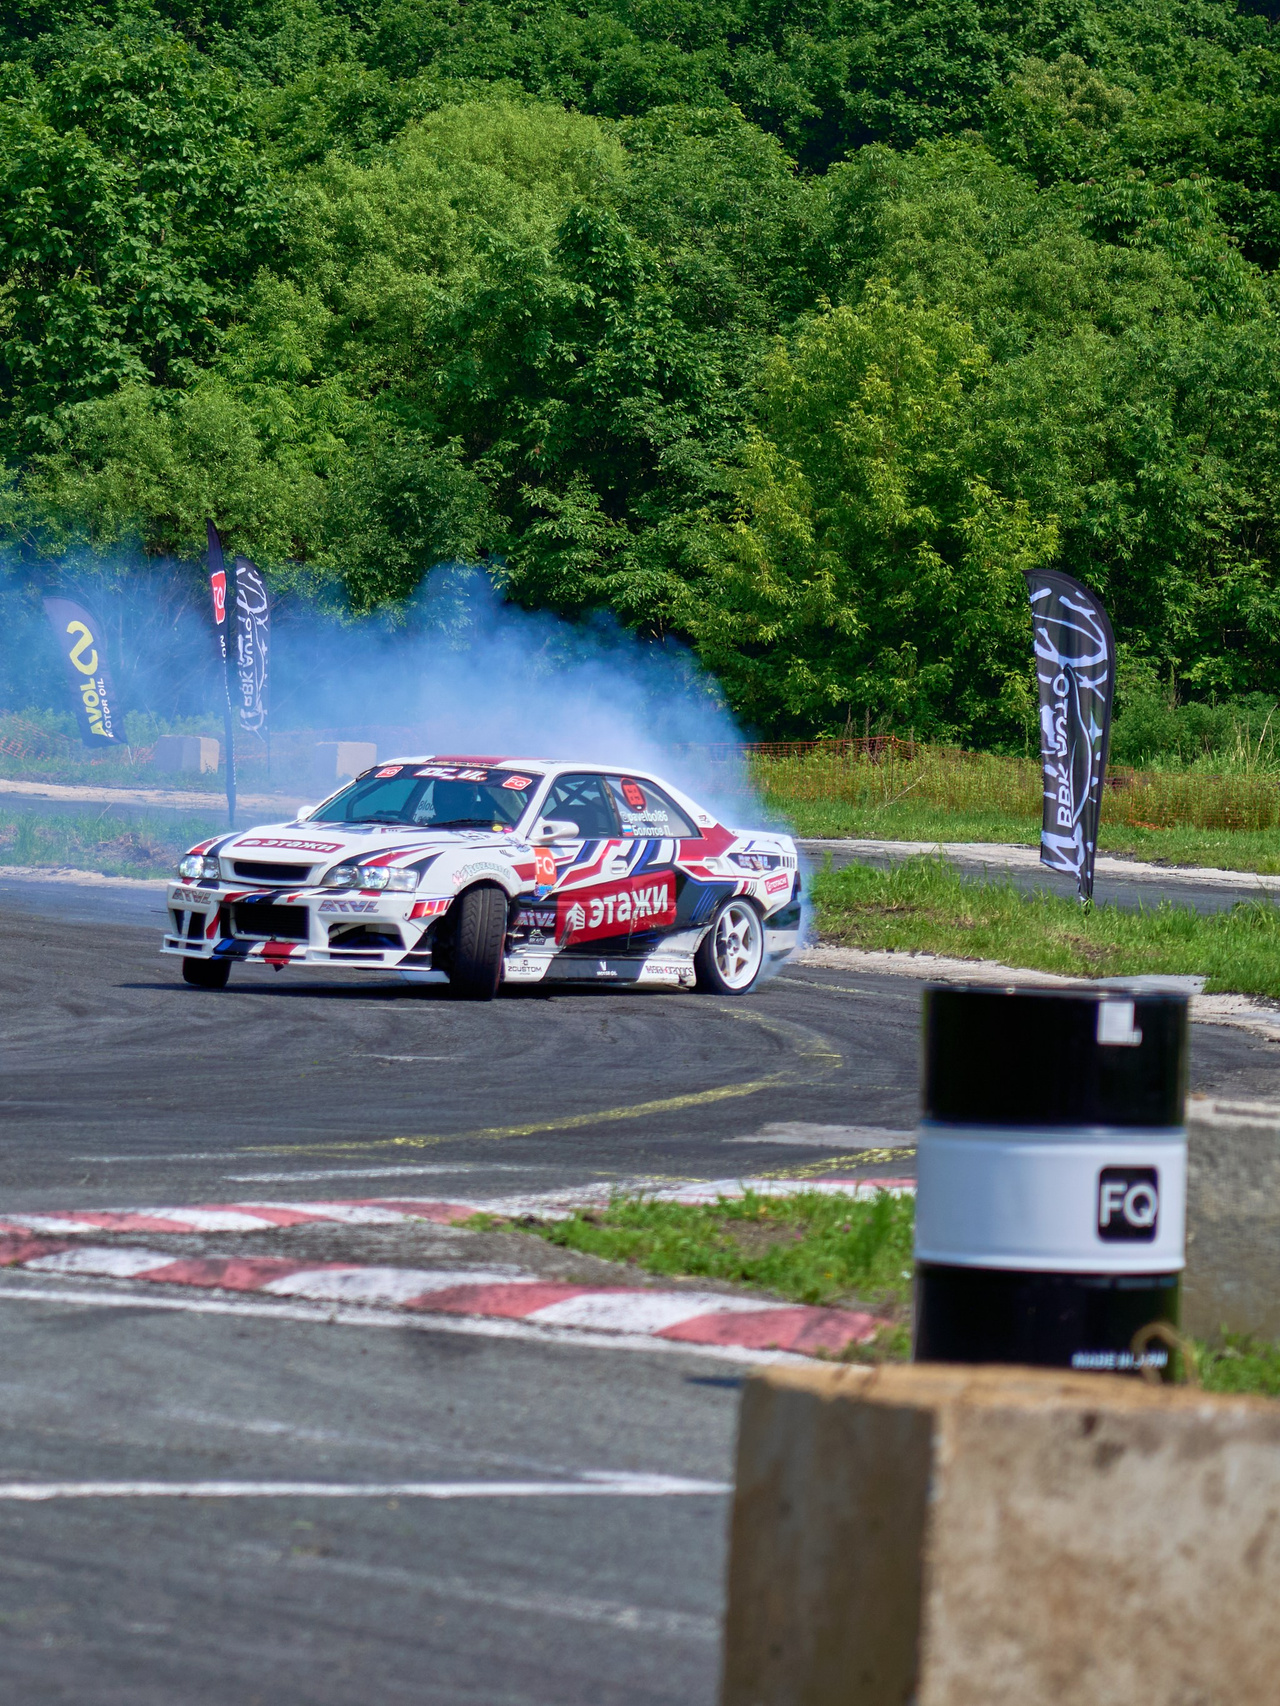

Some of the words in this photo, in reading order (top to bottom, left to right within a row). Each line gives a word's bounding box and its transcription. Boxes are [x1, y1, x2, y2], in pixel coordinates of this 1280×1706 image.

[97, 678, 107, 696] OIL
[80, 678, 108, 737] AVOL
[101, 699, 114, 738] MOTOR
[535, 855, 555, 875] FQ
[171, 888, 212, 904] ATVL
[317, 899, 380, 914] ATVL
[513, 911, 556, 927] ATVL
[1099, 1182, 1158, 1227] FQ
